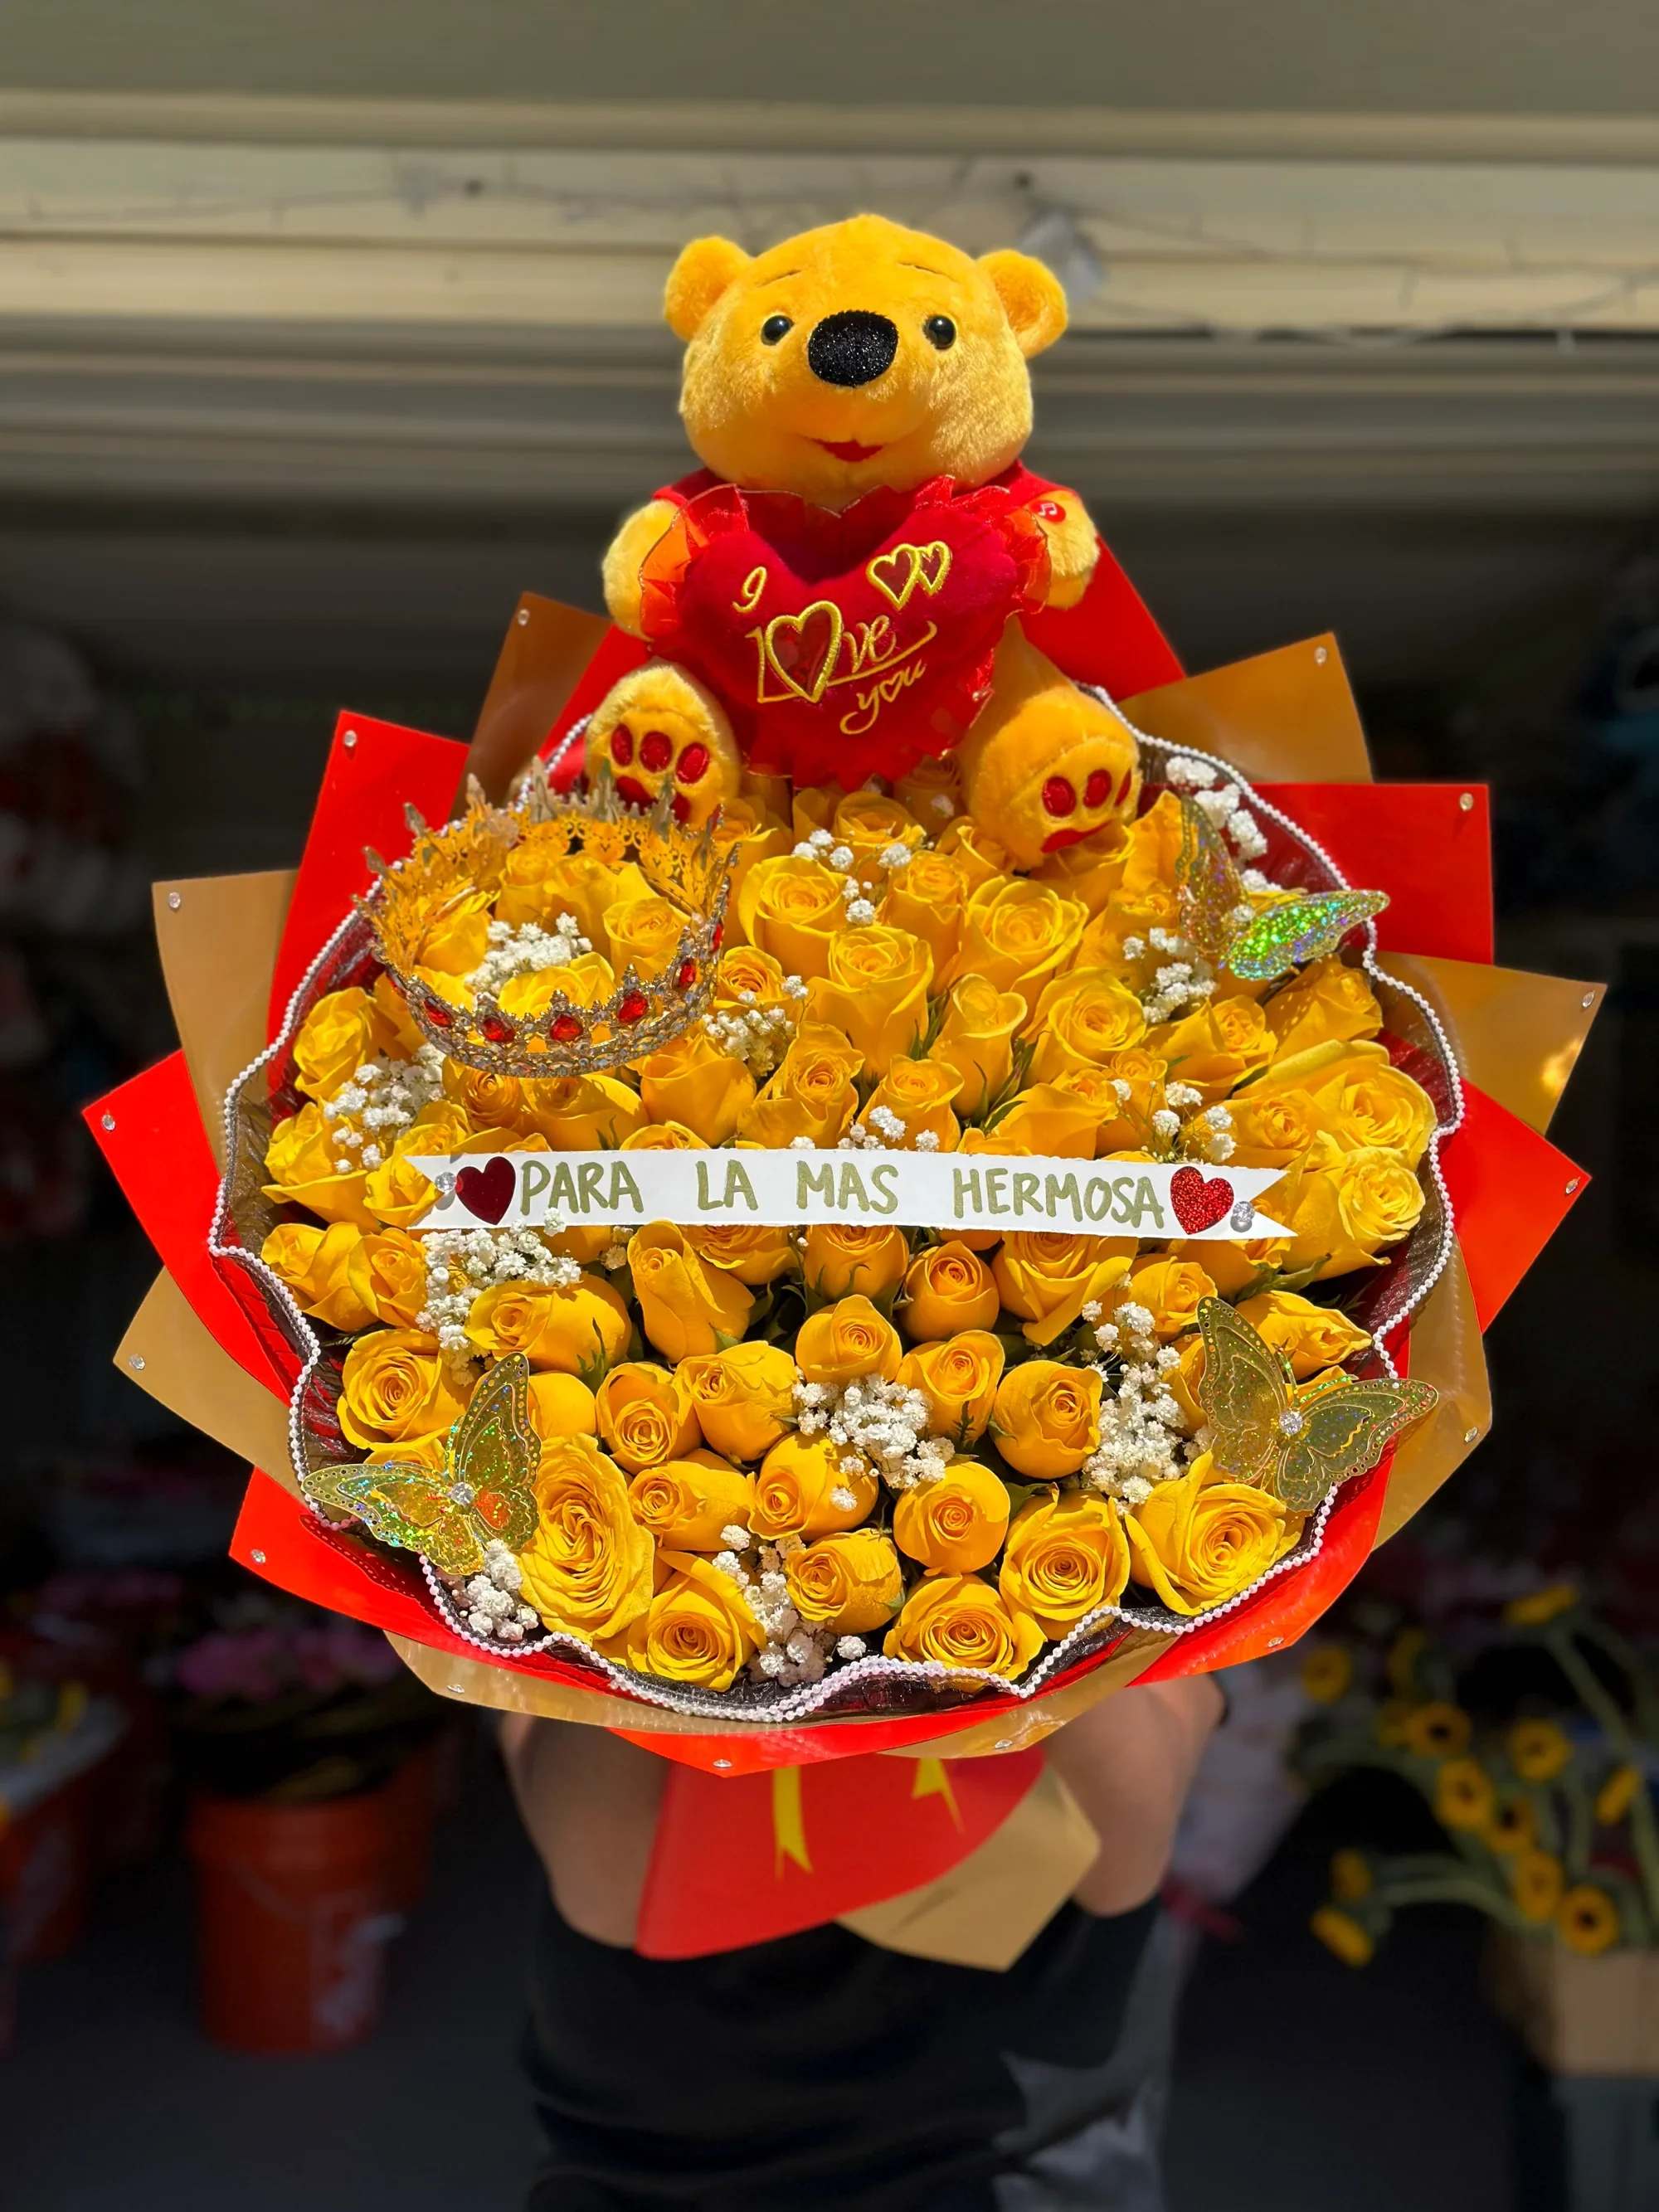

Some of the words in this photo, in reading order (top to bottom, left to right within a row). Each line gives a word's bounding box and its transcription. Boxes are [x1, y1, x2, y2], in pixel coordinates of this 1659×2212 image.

[732, 566, 767, 614] I
[520, 1159, 645, 1216] PARA
[695, 1159, 758, 1212] LA
[795, 1159, 899, 1215] MAS
[952, 1167, 1165, 1229] HERMOSA
